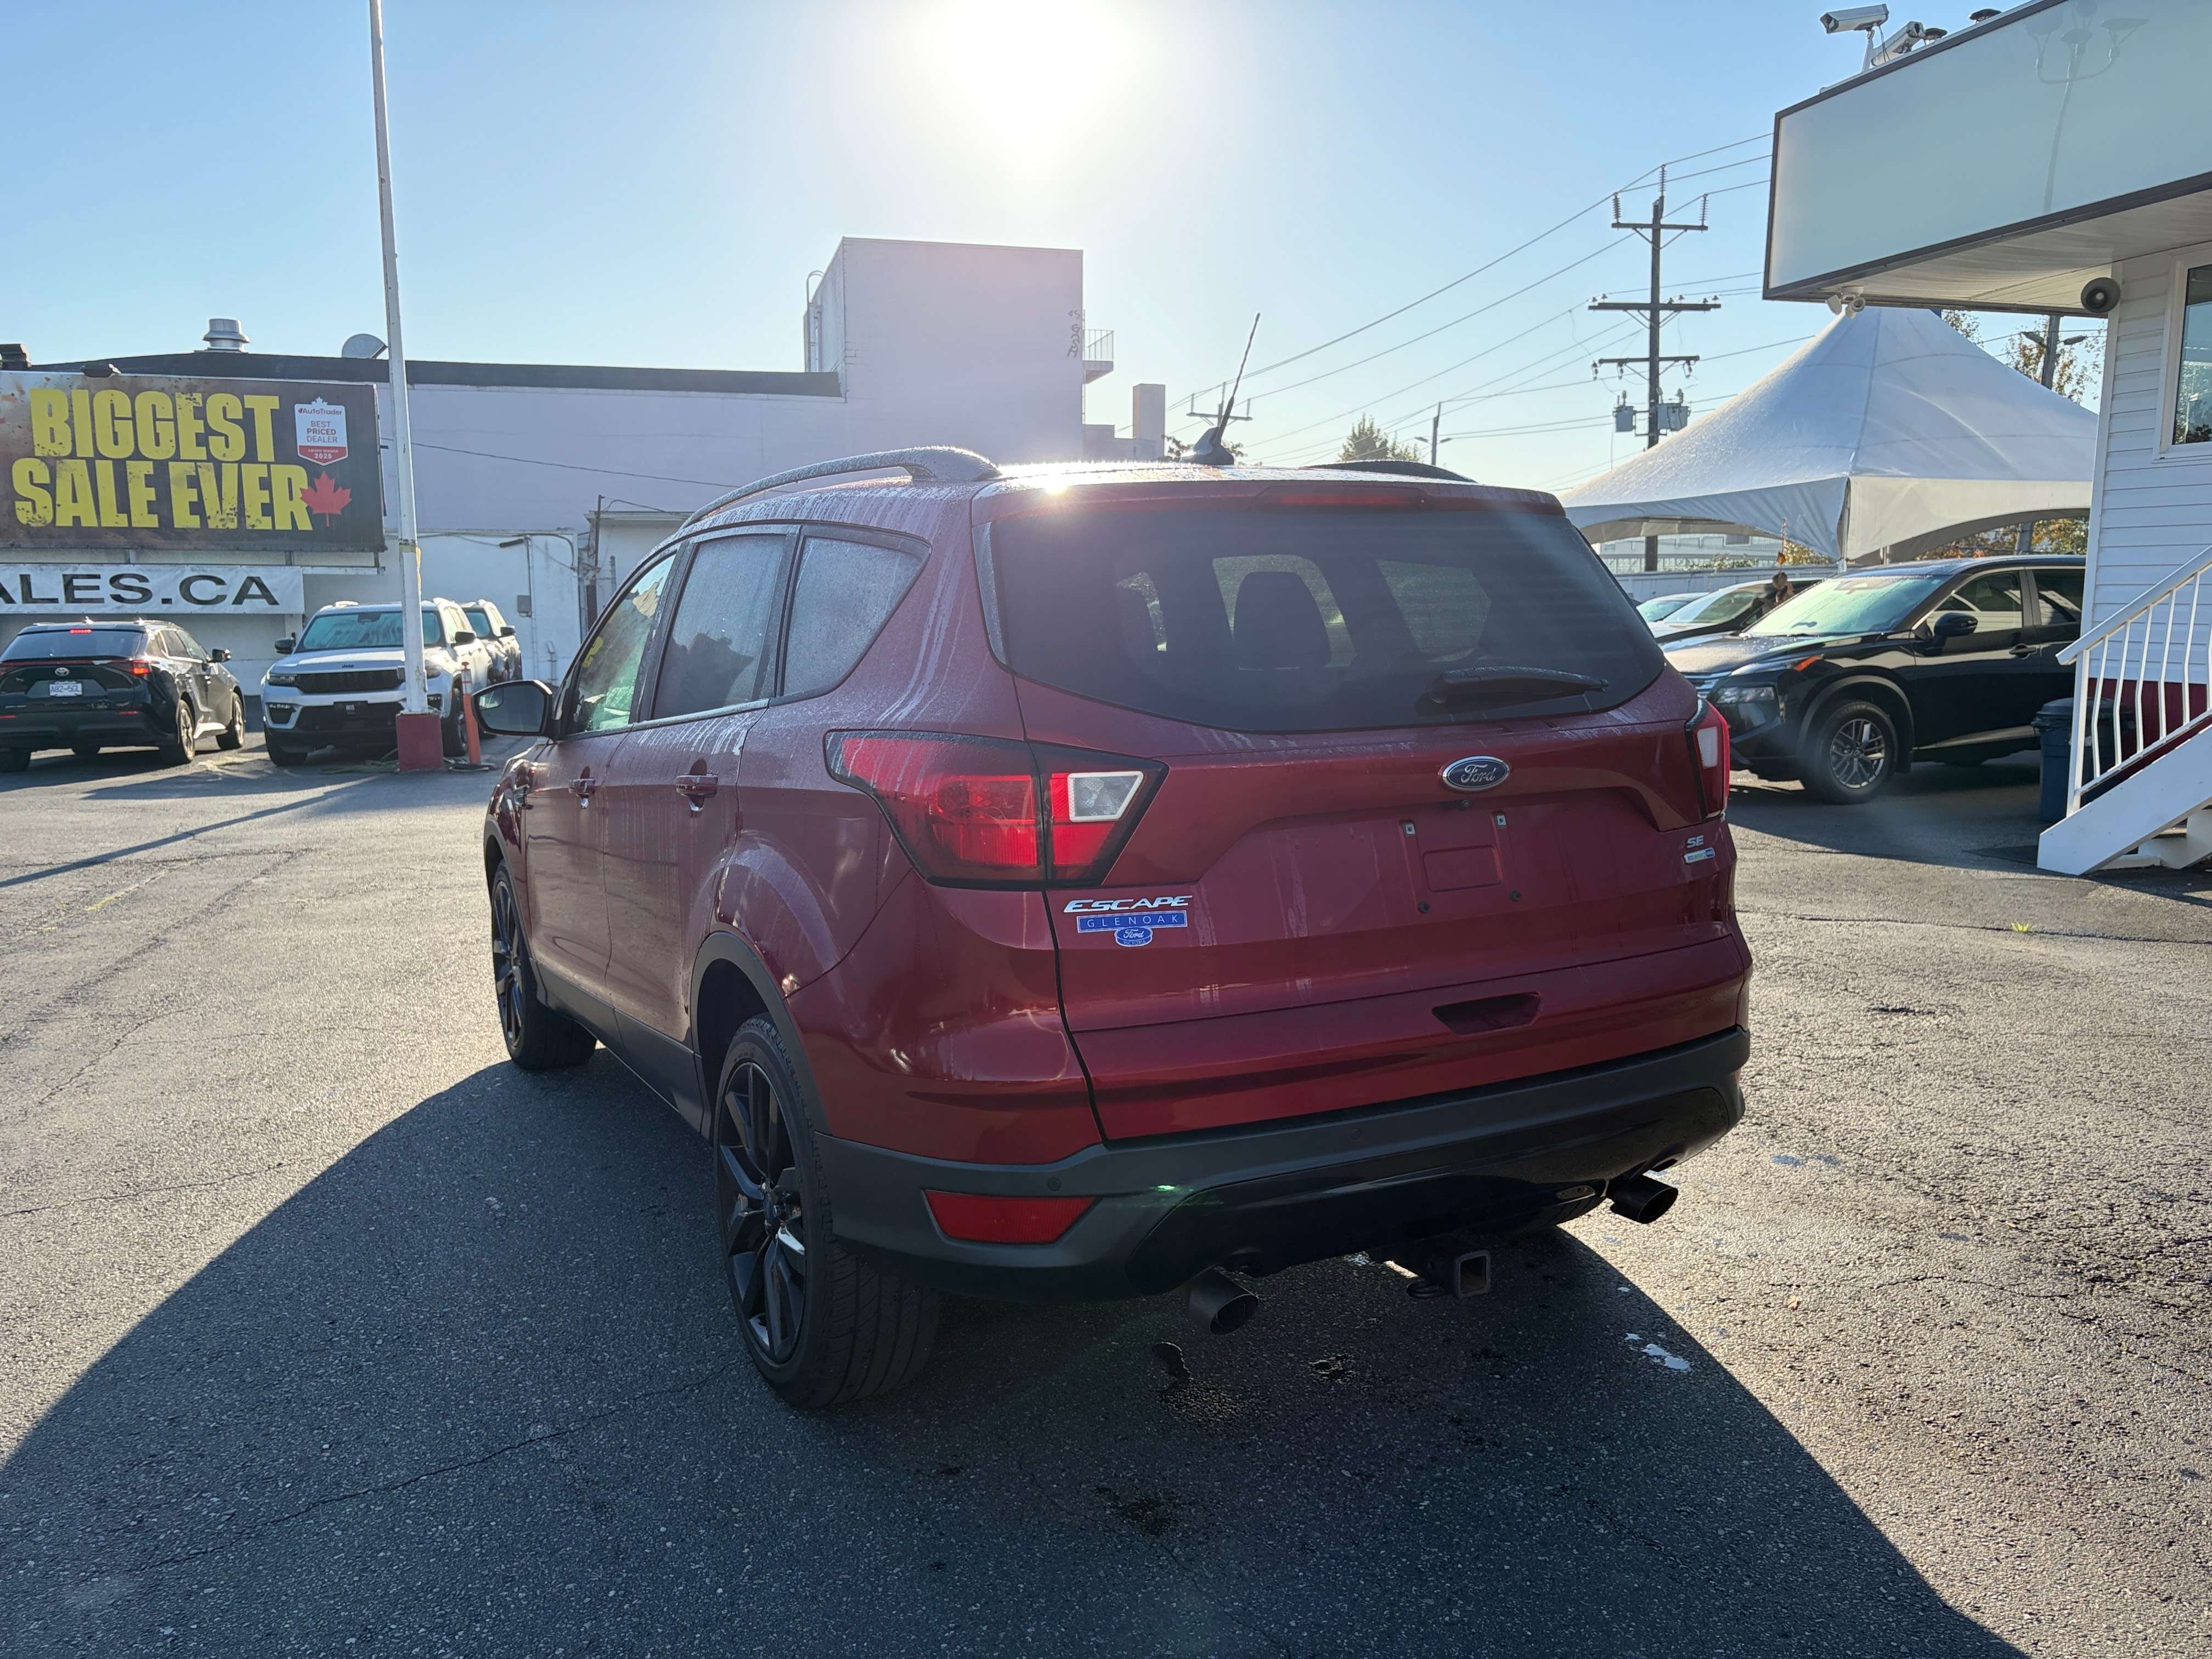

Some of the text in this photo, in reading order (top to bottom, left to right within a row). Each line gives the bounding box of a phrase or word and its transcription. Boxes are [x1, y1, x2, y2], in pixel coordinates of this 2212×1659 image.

[29, 388, 280, 462] BIGGEST
[11, 457, 313, 531] SALE EVER
[1460, 764, 1497, 783] Ford
[1686, 834, 1705, 849] SE
[1063, 895, 1193, 913] ESCAPE
[1087, 915, 1179, 928] GLENOAK
[1123, 929, 1144, 939] Ford
